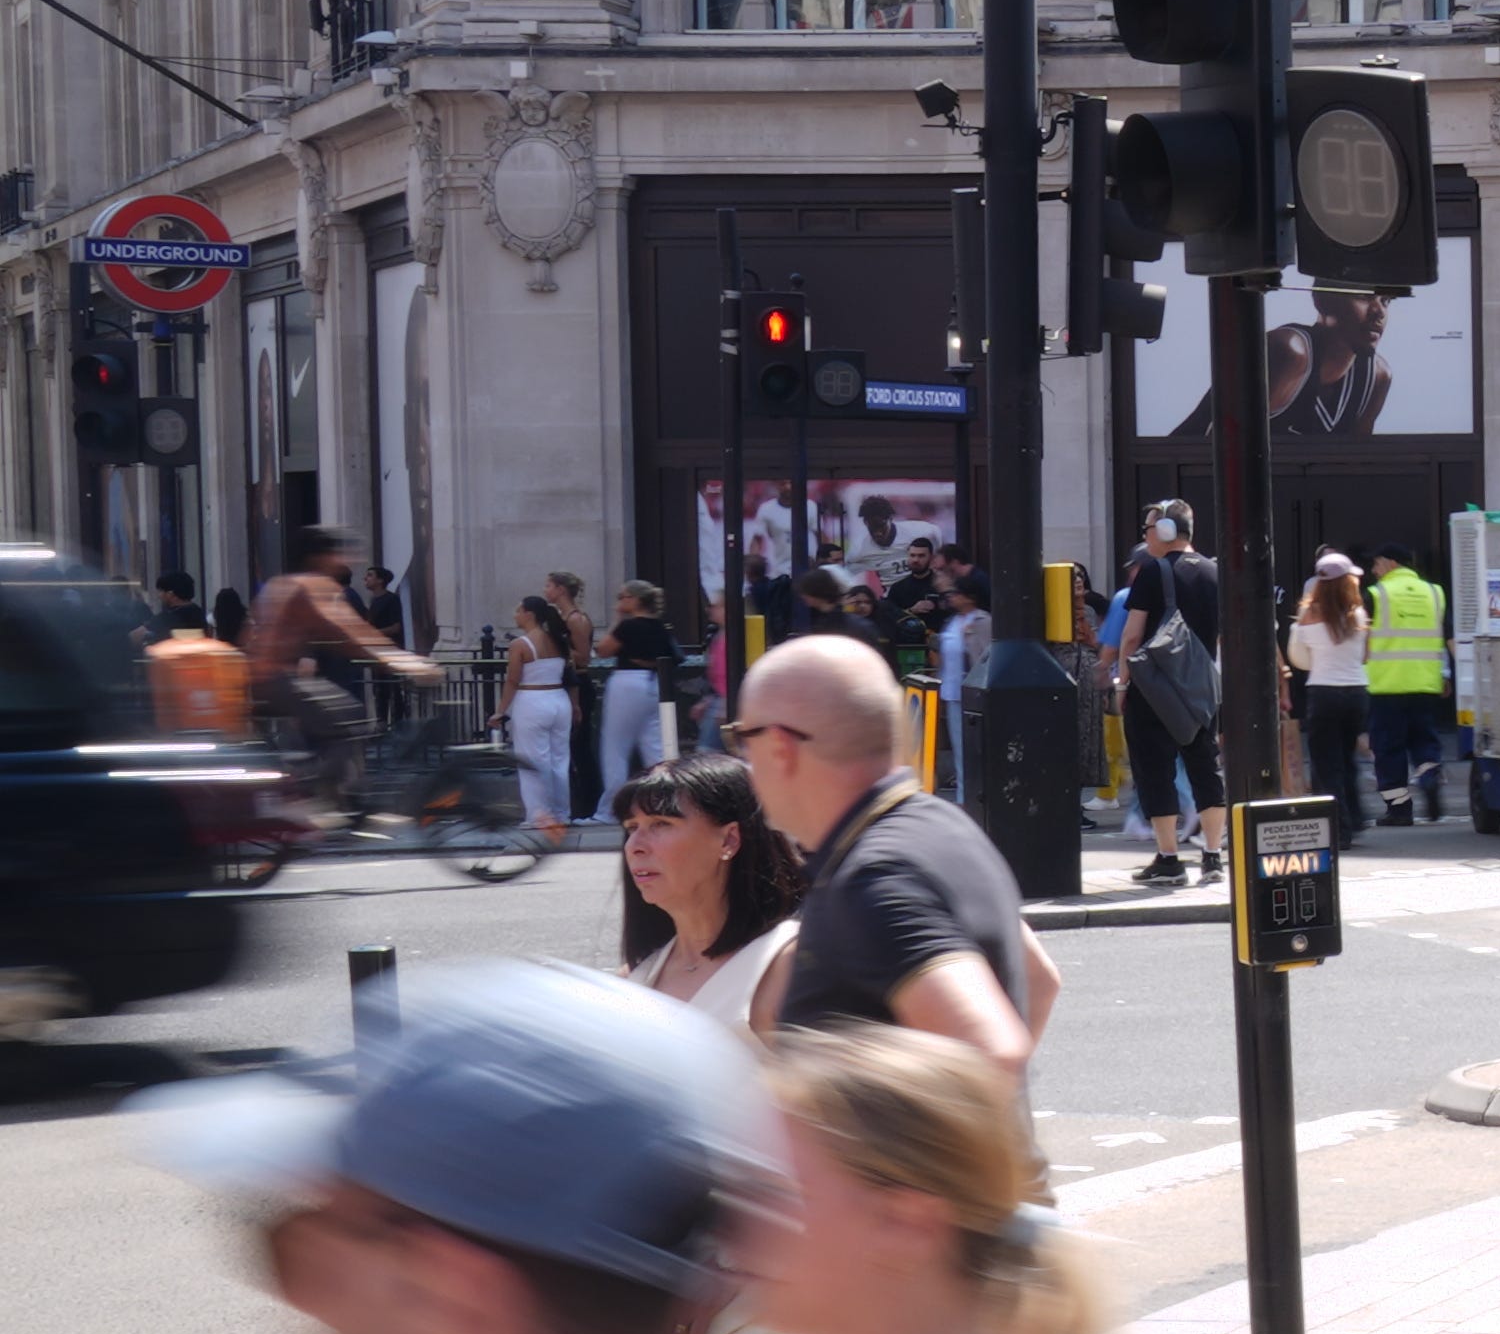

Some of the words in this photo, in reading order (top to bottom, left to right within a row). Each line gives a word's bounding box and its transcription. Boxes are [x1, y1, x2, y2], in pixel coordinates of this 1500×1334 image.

[90, 243, 243, 262] UNDERGROUND
[866, 387, 892, 404] FORD
[892, 389, 923, 405] CIRCUS
[924, 391, 961, 407] STATION
[1264, 823, 1320, 834] PEDESTRIANS
[1262, 851, 1320, 878] WAIT
